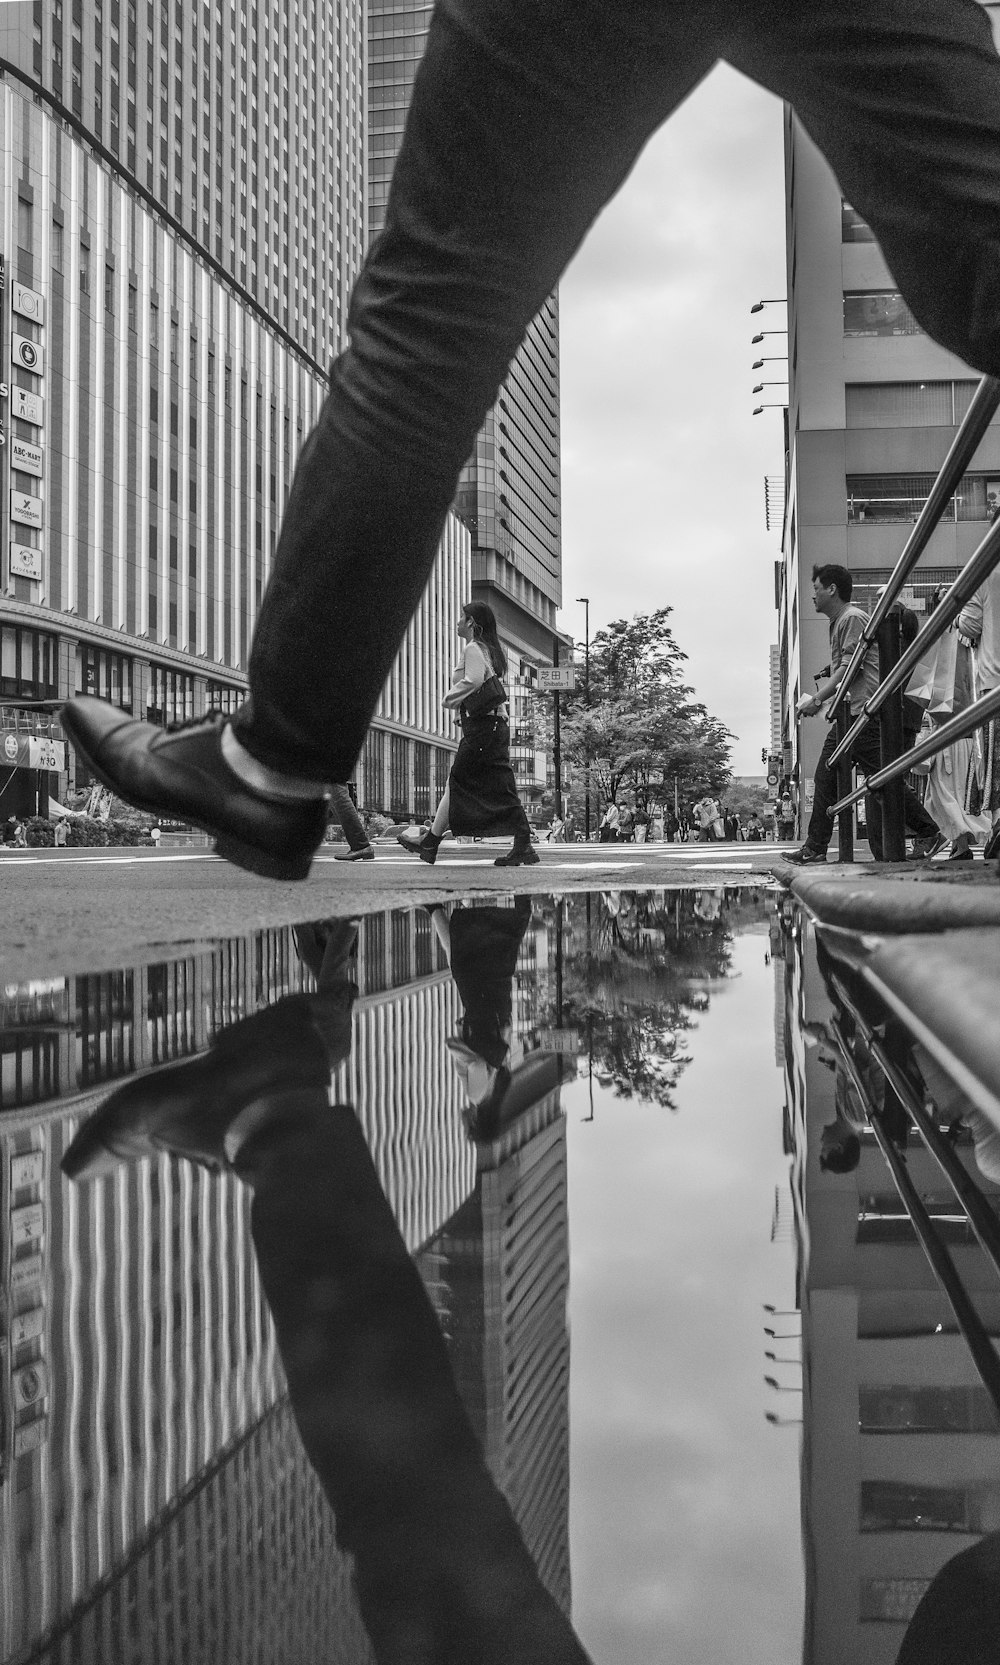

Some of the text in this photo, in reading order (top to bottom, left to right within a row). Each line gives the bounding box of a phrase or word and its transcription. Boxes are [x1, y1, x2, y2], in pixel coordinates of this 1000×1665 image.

[13, 446, 41, 462] ABC-MART
[14, 507, 40, 519] YODOBASHI
[540, 670, 569, 680] 芝田 1
